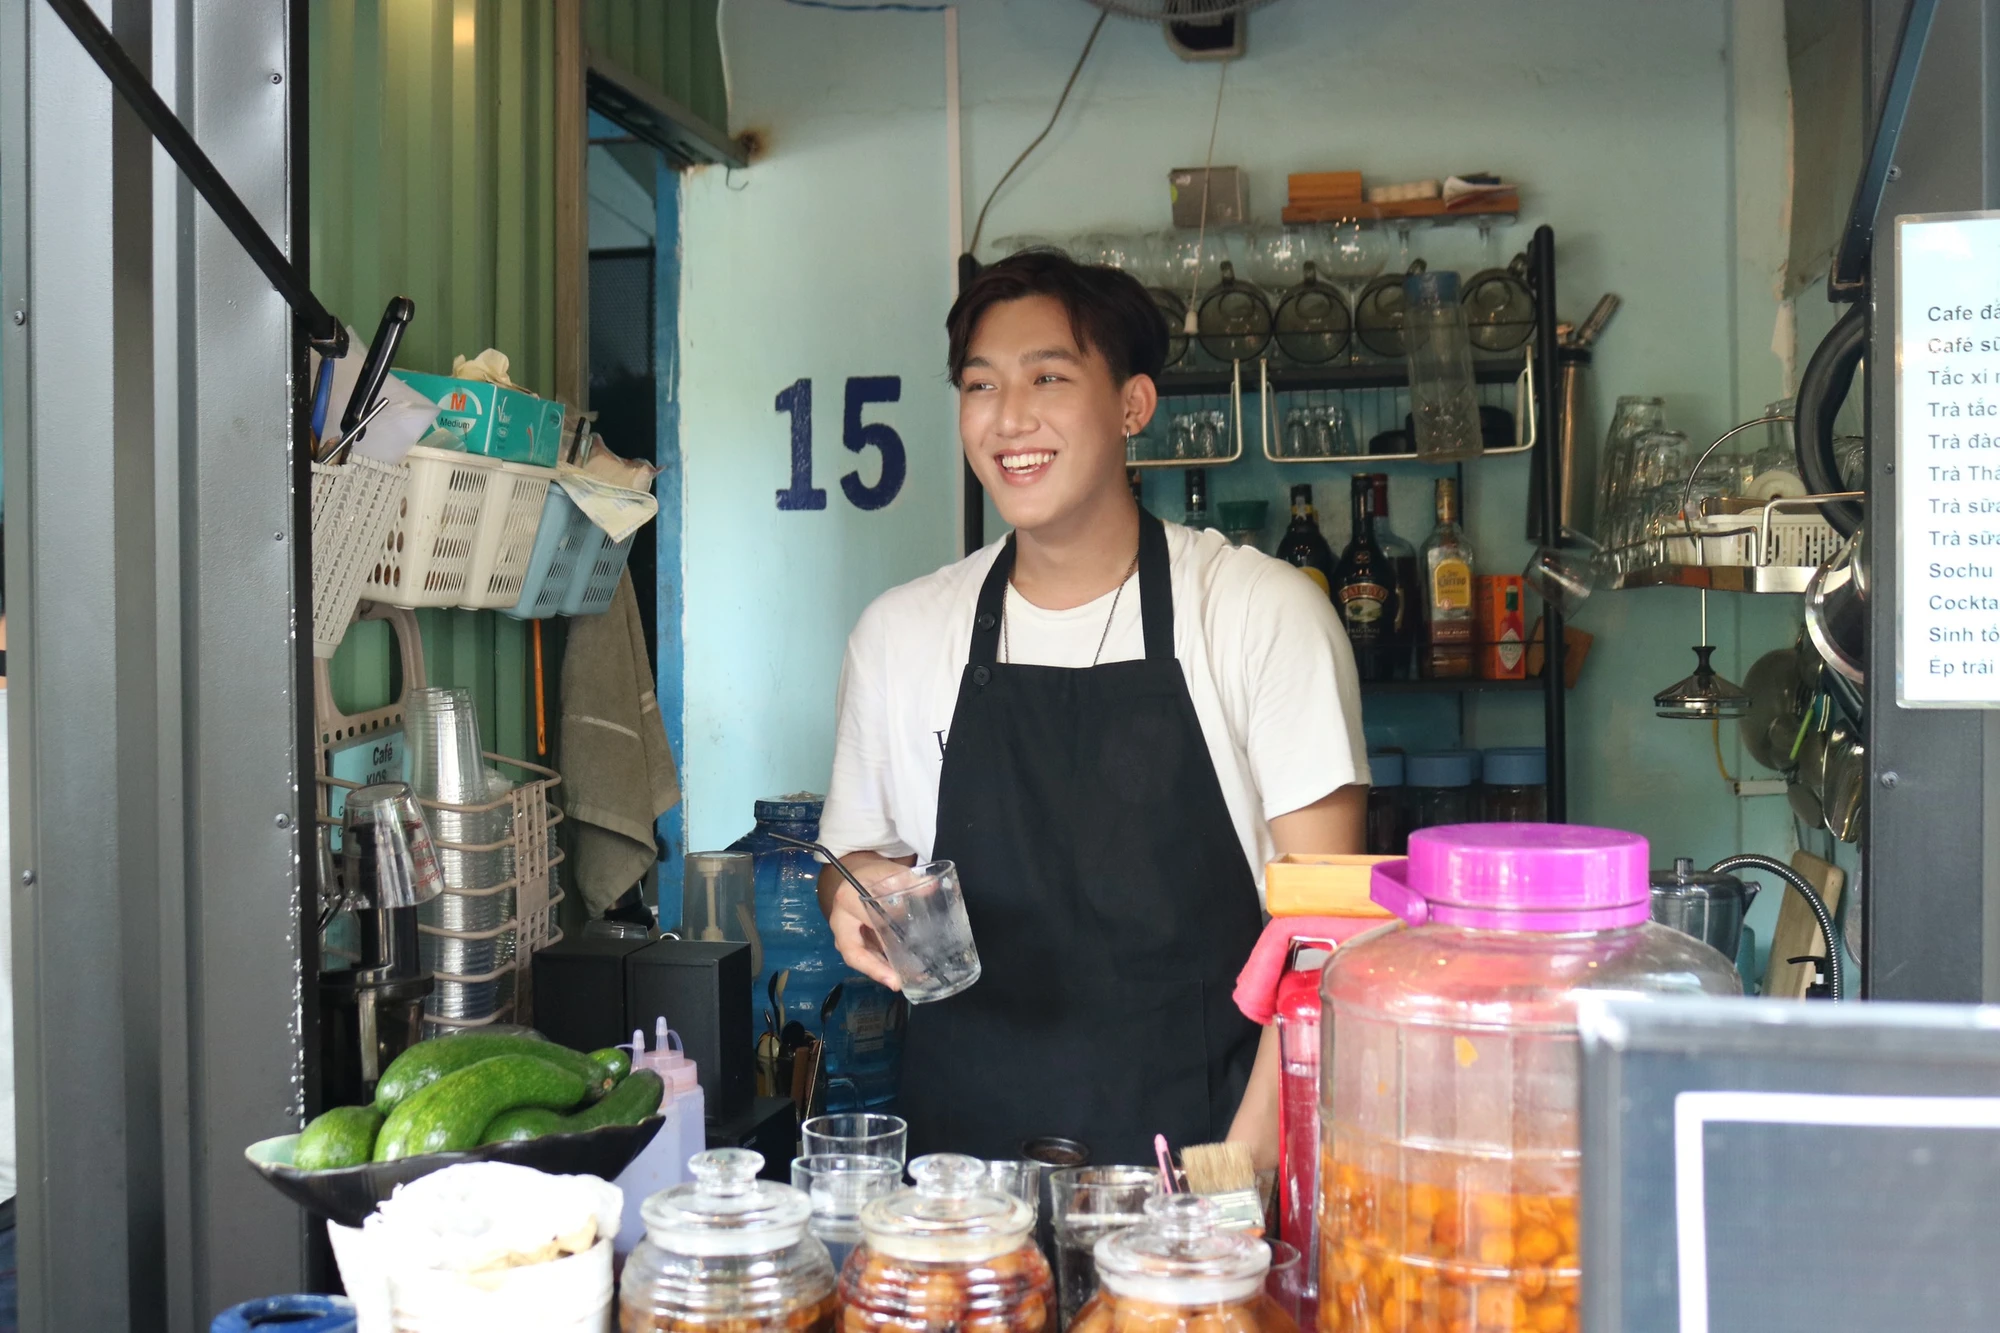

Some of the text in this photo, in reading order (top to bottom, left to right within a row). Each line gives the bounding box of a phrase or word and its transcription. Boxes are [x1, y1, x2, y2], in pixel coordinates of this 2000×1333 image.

[1928, 305, 1973, 322] Cafe
[450, 393, 467, 411] M
[1927, 401, 1961, 418] Trà
[440, 417, 471, 429] Medium
[775, 375, 906, 511] 15
[1928, 434, 1961, 449] Trà
[1928, 466, 1961, 481] Trà
[1928, 498, 1961, 514] Trà
[1928, 530, 1961, 546] Trà
[1929, 563, 1993, 578] Sochu
[1929, 627, 1974, 642] Sinh
